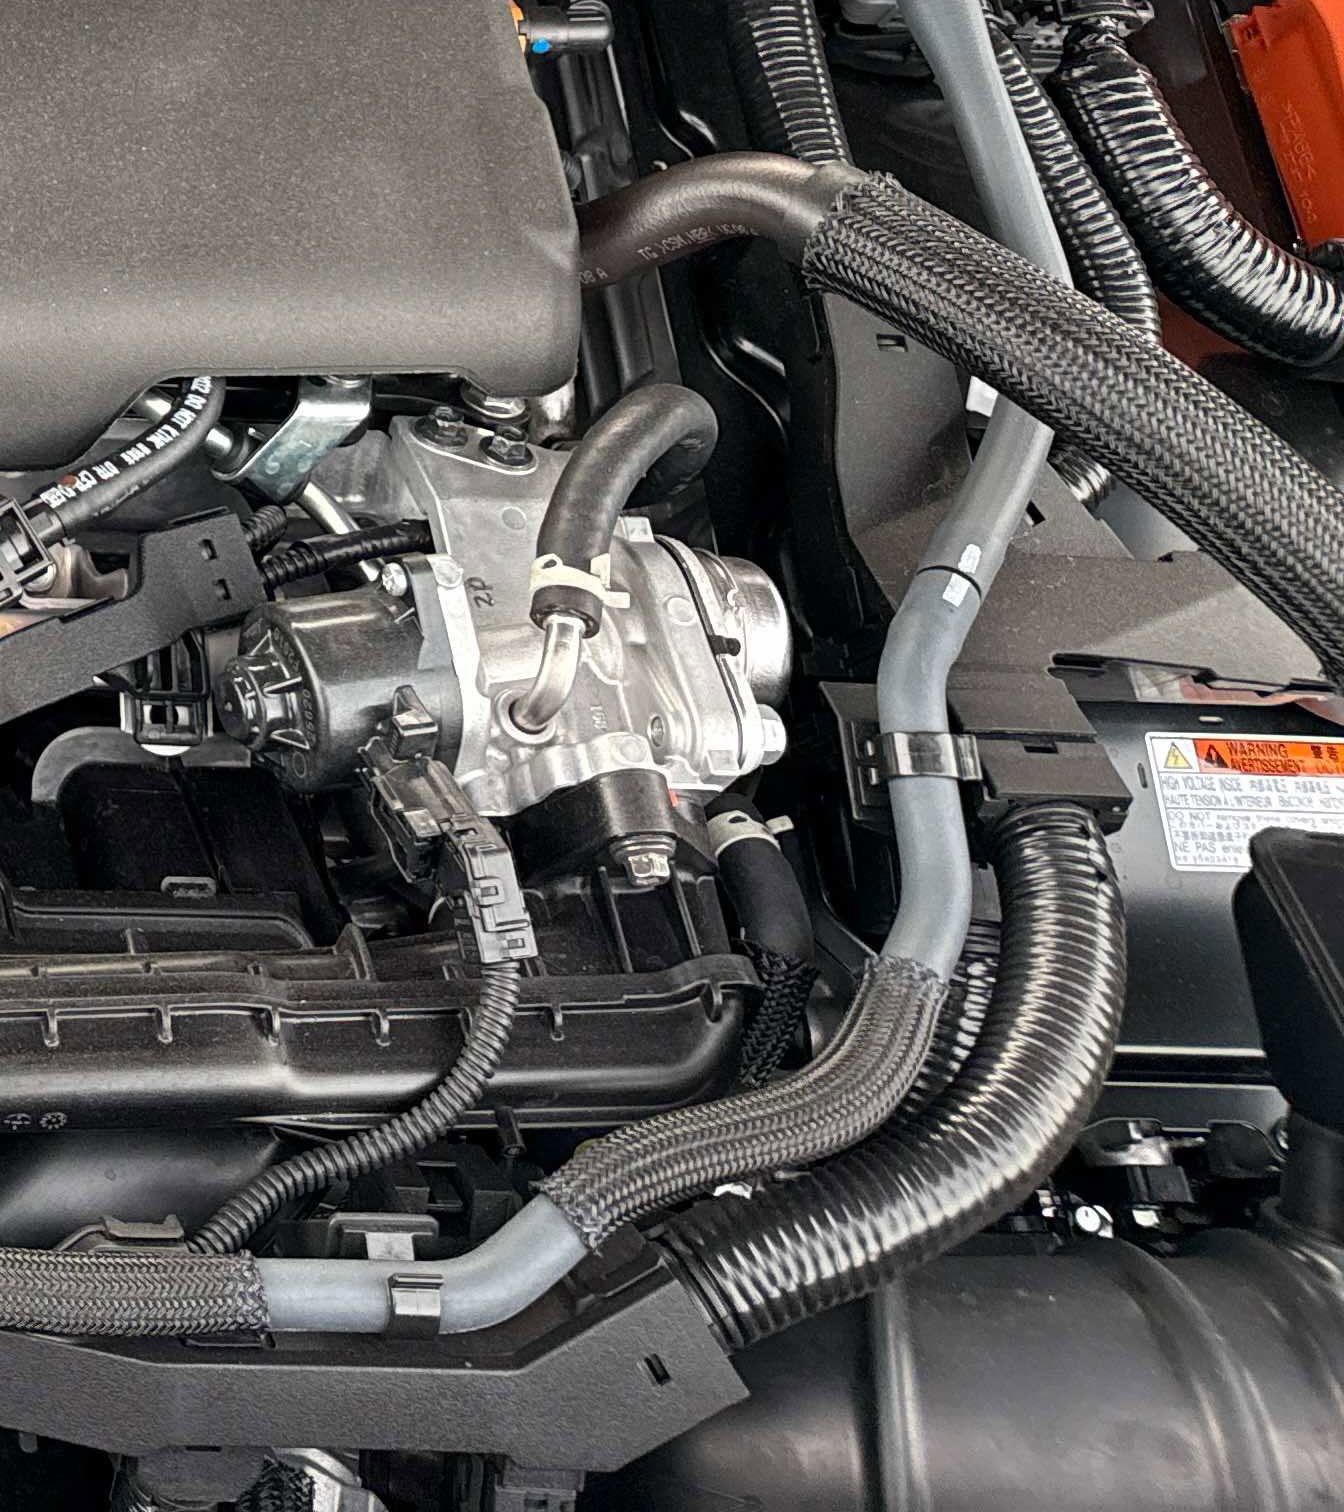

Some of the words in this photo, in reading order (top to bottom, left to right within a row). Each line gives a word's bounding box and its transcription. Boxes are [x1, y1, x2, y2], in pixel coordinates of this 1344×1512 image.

[1226, 742, 1289, 758] WARNING
[1167, 811, 1183, 821] DO
[1189, 812, 1211, 822] NOT
[1196, 842, 1217, 853] PAS
